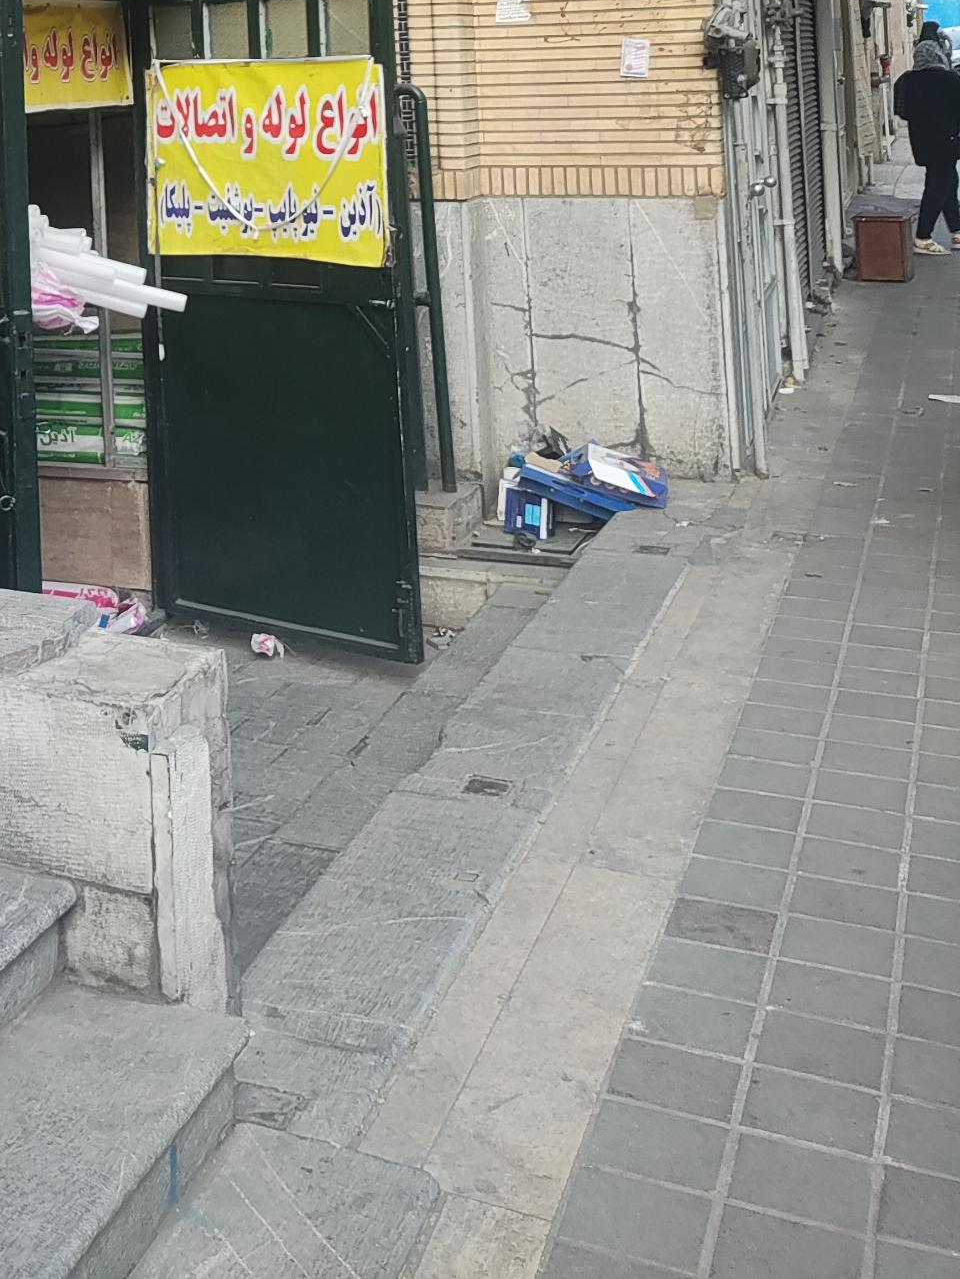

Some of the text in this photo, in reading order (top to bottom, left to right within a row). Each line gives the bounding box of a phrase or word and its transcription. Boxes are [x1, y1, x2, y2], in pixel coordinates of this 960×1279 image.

[44, 29, 74, 81] لوله
[80, 30, 118, 81] انواع
[156, 90, 379, 155] انواع لوله و اتصالات
